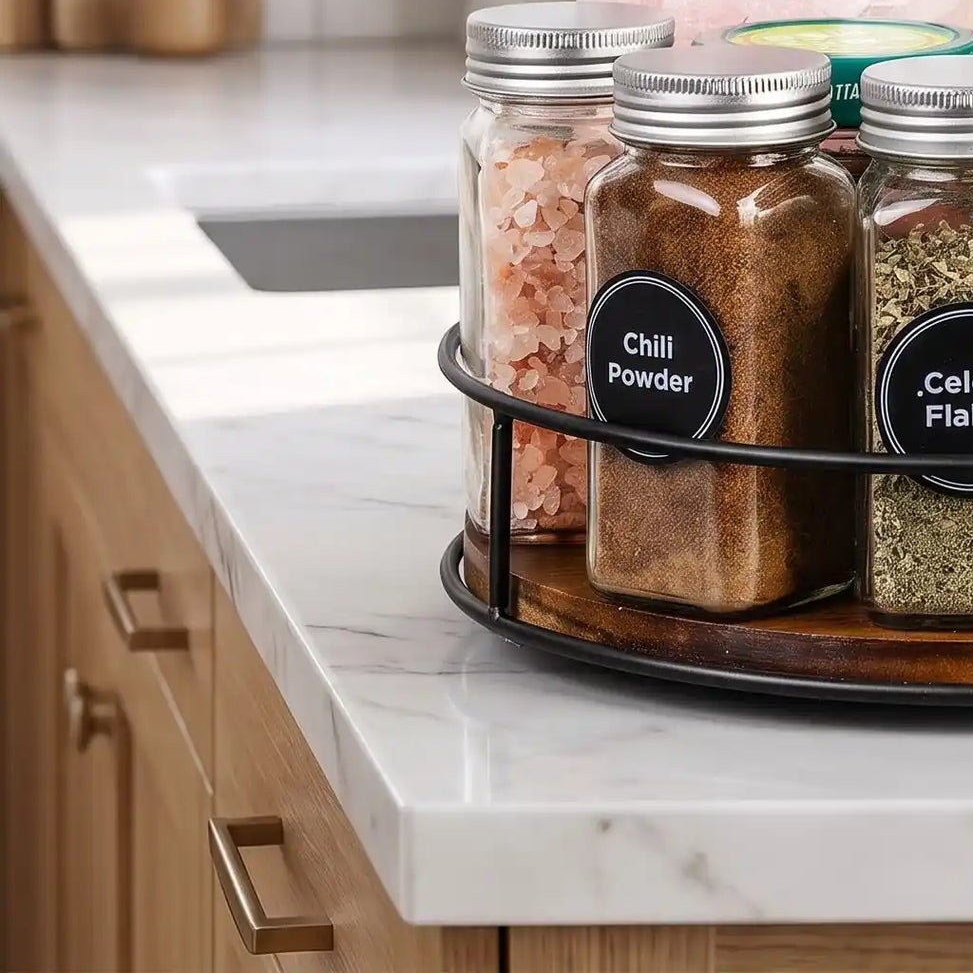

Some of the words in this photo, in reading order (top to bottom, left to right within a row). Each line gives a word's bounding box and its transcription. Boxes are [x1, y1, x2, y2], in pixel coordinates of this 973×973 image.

[830, 83, 860, 101] TTA
[623, 332, 673, 359] Chili
[608, 362, 693, 393] Powder
